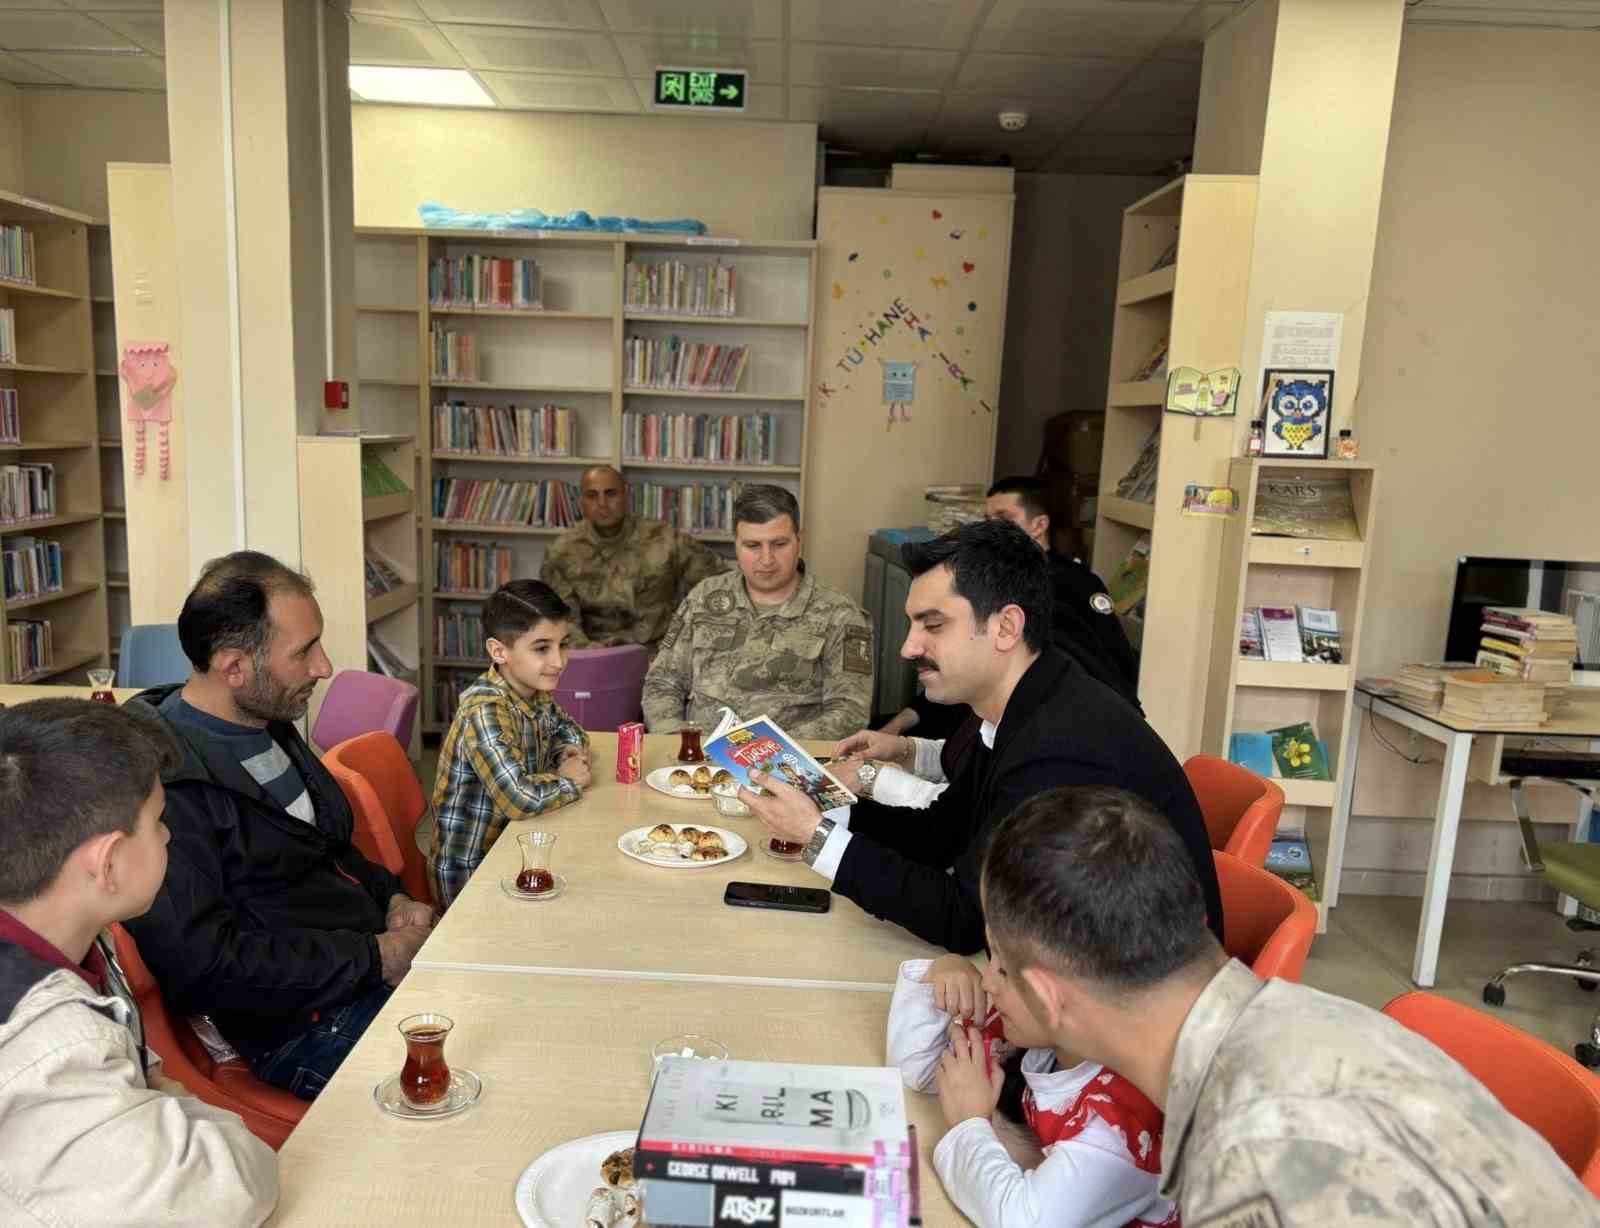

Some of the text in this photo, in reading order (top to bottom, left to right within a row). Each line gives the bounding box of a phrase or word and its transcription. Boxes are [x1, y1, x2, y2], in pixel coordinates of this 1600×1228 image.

[689, 72, 717, 88] EXIT
[1267, 484, 1319, 497] KARS
[711, 1164, 759, 1183] ORWELL
[720, 1194, 775, 1225] ATSIZ
